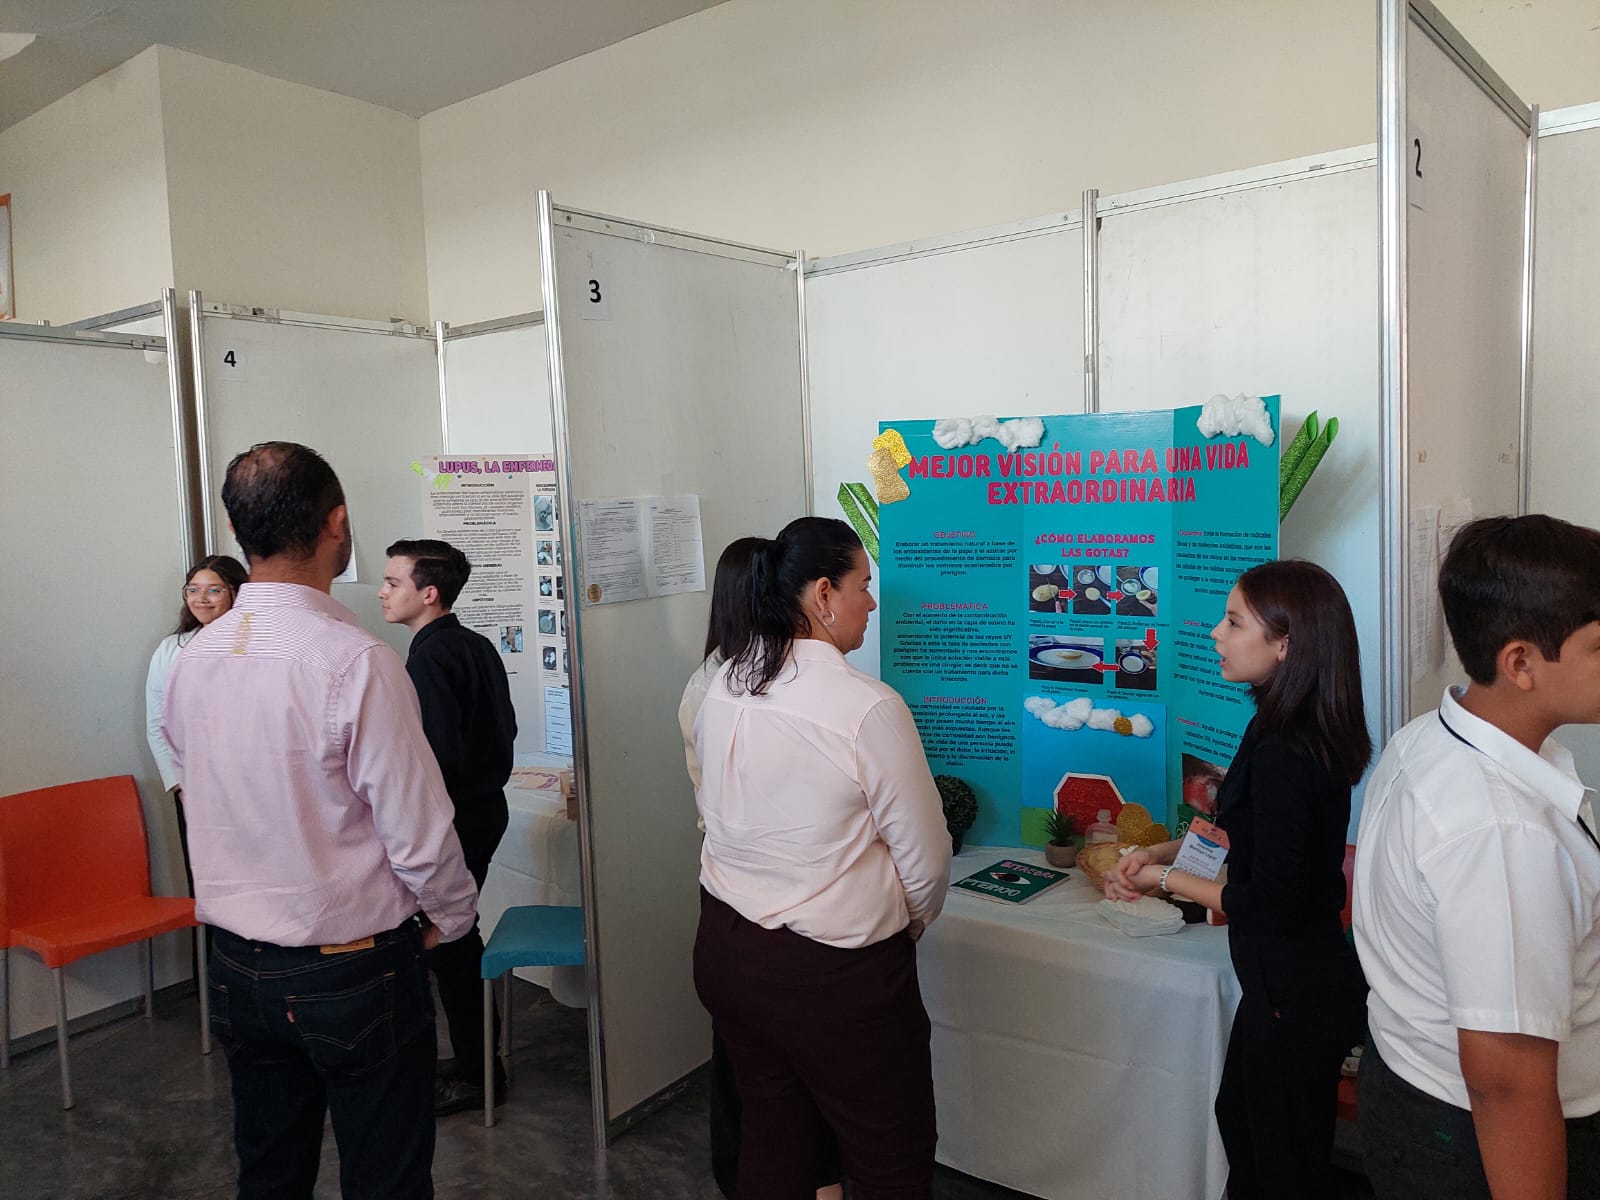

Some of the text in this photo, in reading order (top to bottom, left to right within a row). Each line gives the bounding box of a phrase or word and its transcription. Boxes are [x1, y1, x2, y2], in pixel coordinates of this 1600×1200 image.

[588, 280, 602, 303] 3
[224, 350, 237, 368] 4
[439, 461, 482, 474] LUPUS,
[484, 461, 500, 473] LA
[908, 441, 1249, 479] MEJOR VISIÓN PARA UNA VIDA
[987, 476, 1196, 505] EXTRAORDINARIA
[1035, 532, 1155, 544] ¿CÓMO ELABORAMOS
[1062, 548, 1129, 558] LAS GOTAS?
[924, 696, 987, 704] INTRODUCCIÓN
